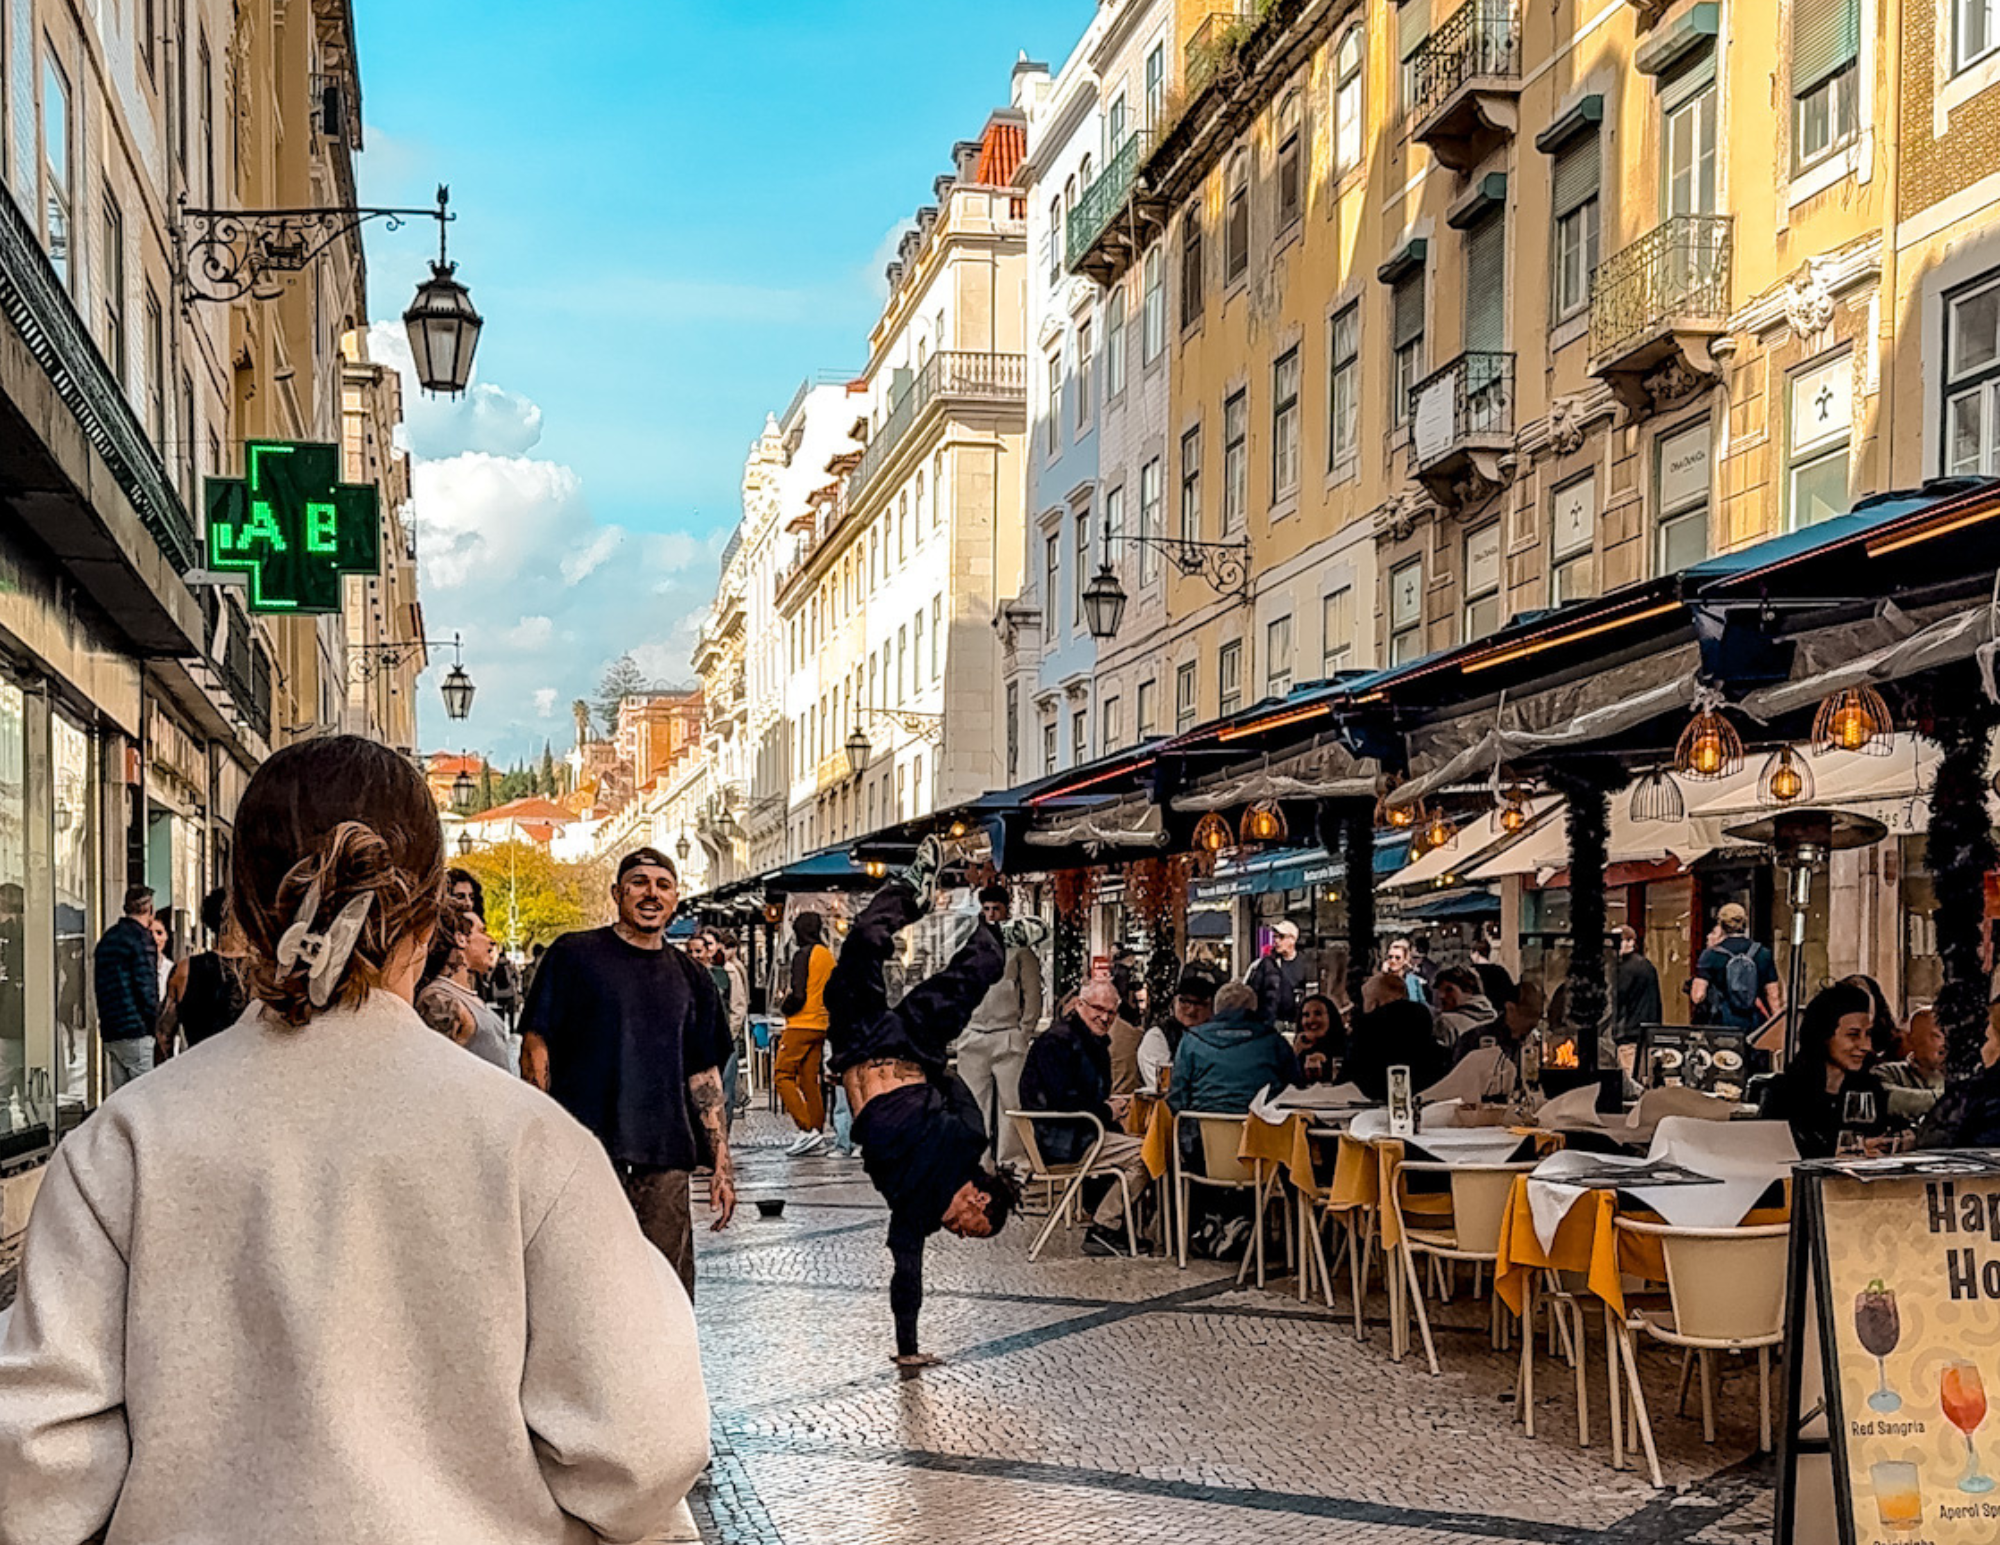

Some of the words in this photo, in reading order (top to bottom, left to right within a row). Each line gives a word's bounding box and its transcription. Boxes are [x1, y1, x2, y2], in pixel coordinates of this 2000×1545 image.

[1946, 1247, 2000, 1300] Ho
[1851, 1420, 1874, 1436] Red
[1877, 1420, 1925, 1437] Sangria
[1940, 1503, 1979, 1521] Aperol
